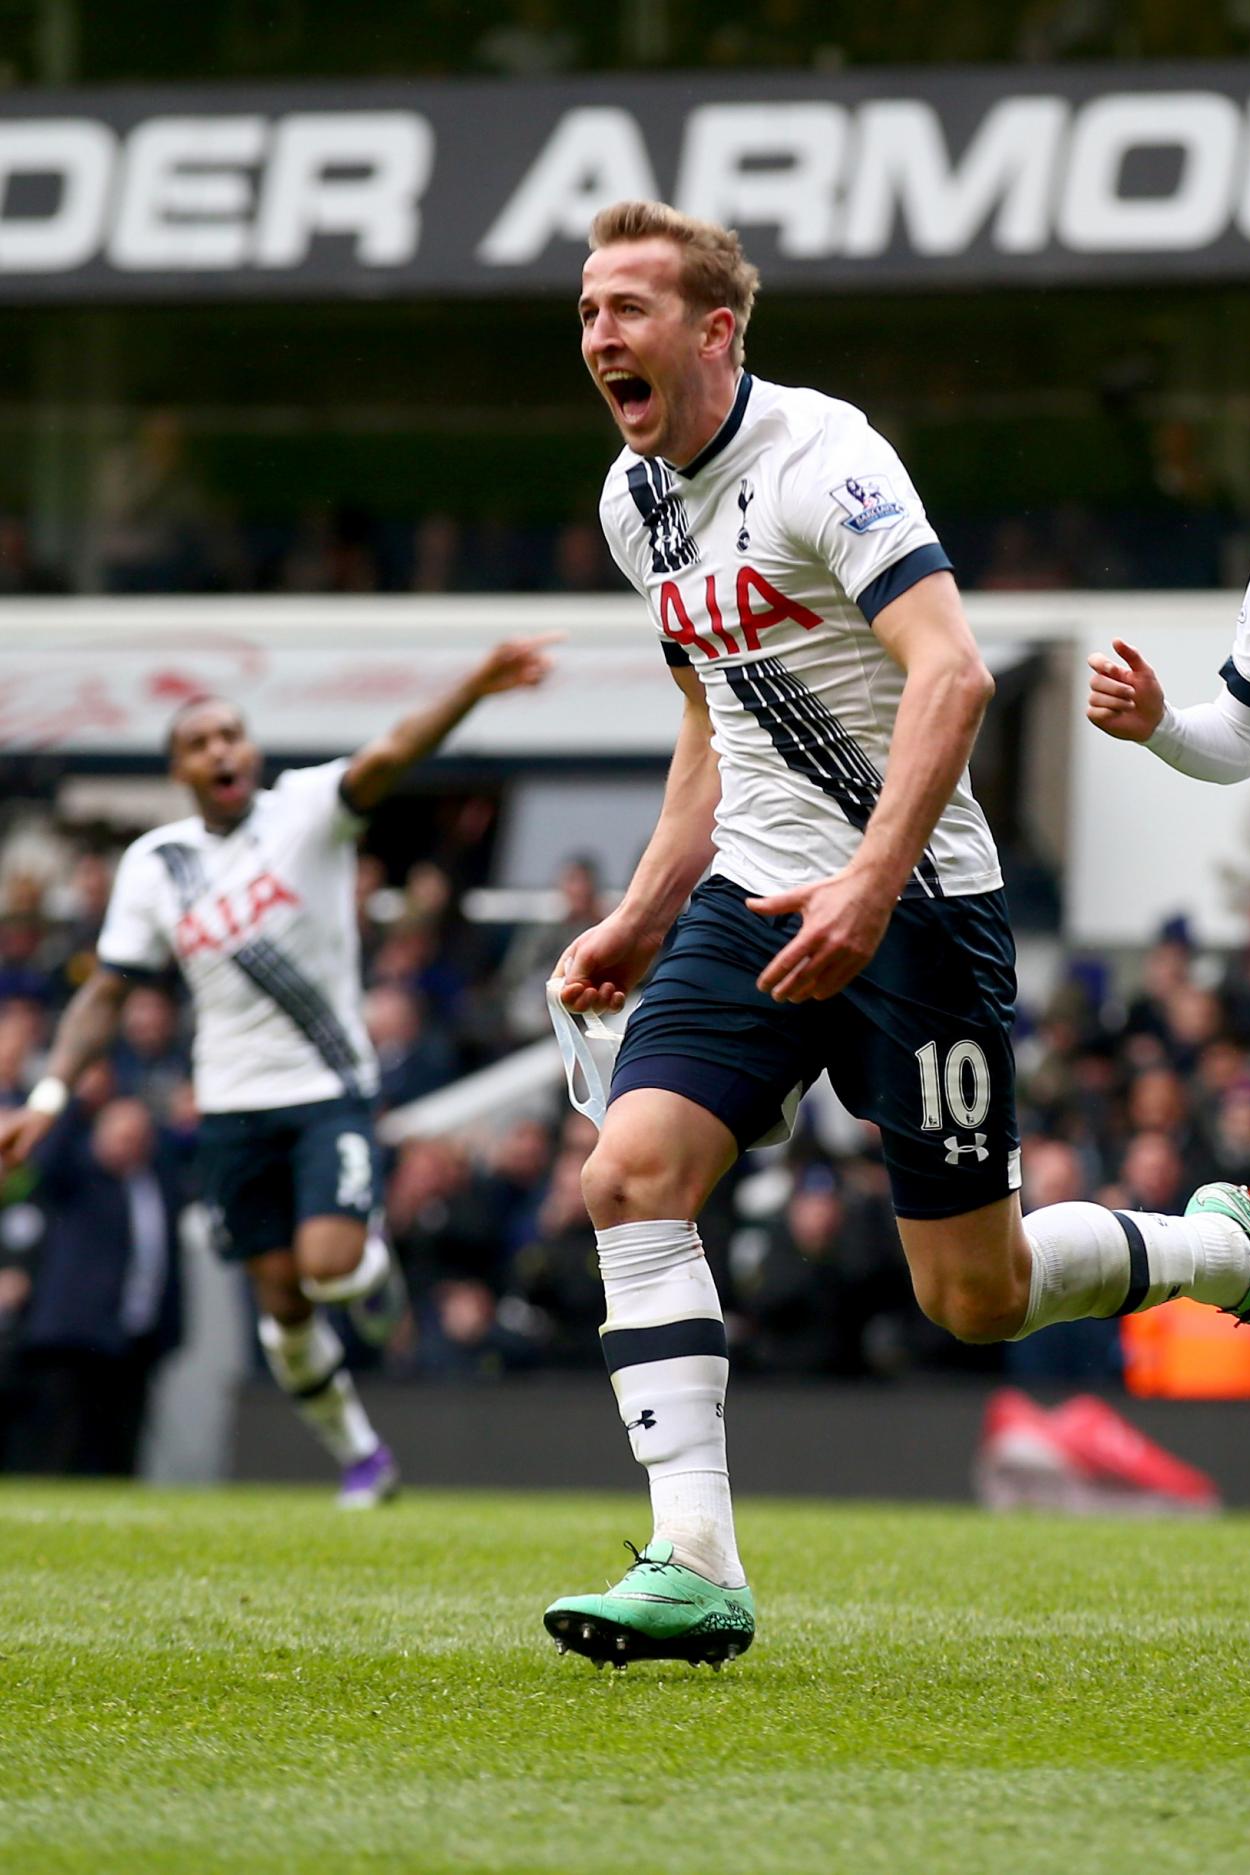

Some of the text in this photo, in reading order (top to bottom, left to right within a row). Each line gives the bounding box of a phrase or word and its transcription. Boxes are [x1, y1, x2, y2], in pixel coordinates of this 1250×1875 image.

[0, 111, 433, 271] DER
[660, 565, 825, 660] AIA
[176, 872, 302, 957] AIA
[915, 1039, 991, 1130] 10
